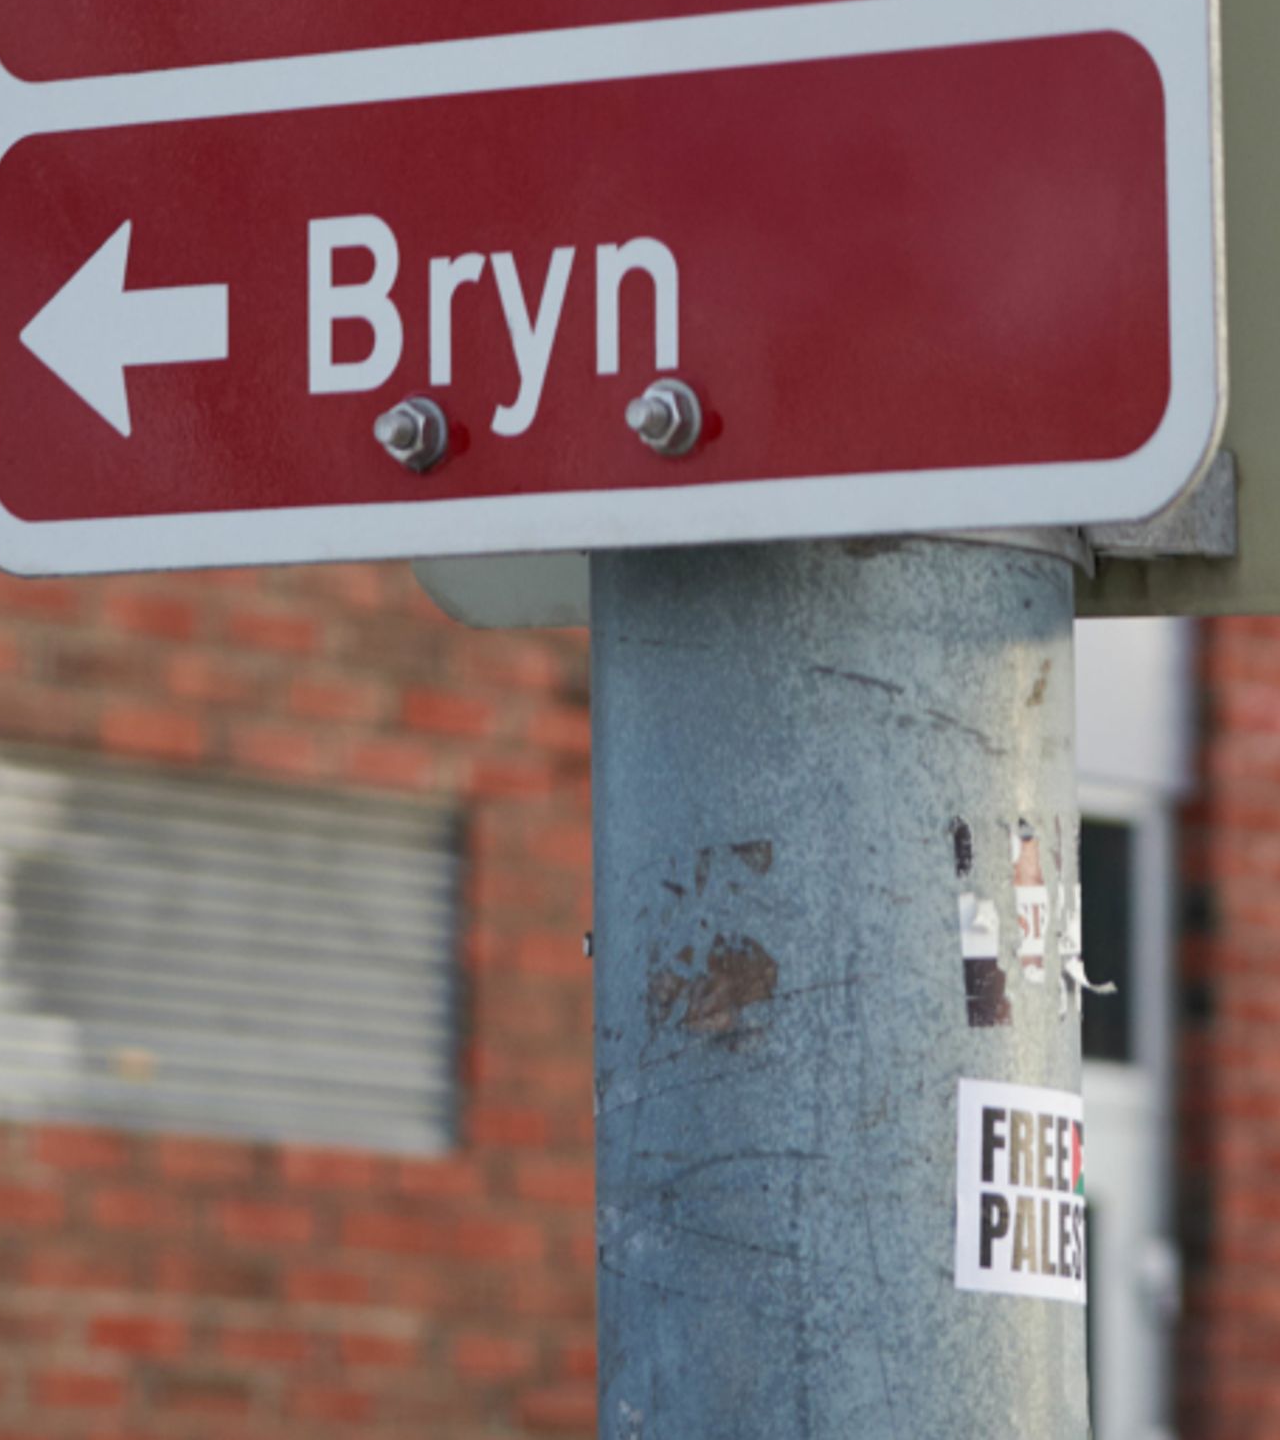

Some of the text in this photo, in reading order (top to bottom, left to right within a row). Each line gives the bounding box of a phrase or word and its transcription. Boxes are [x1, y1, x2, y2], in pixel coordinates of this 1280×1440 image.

[308, 213, 680, 437] Bryn
[981, 1105, 1070, 1192] FREE
[979, 1190, 1085, 1282] PALES
